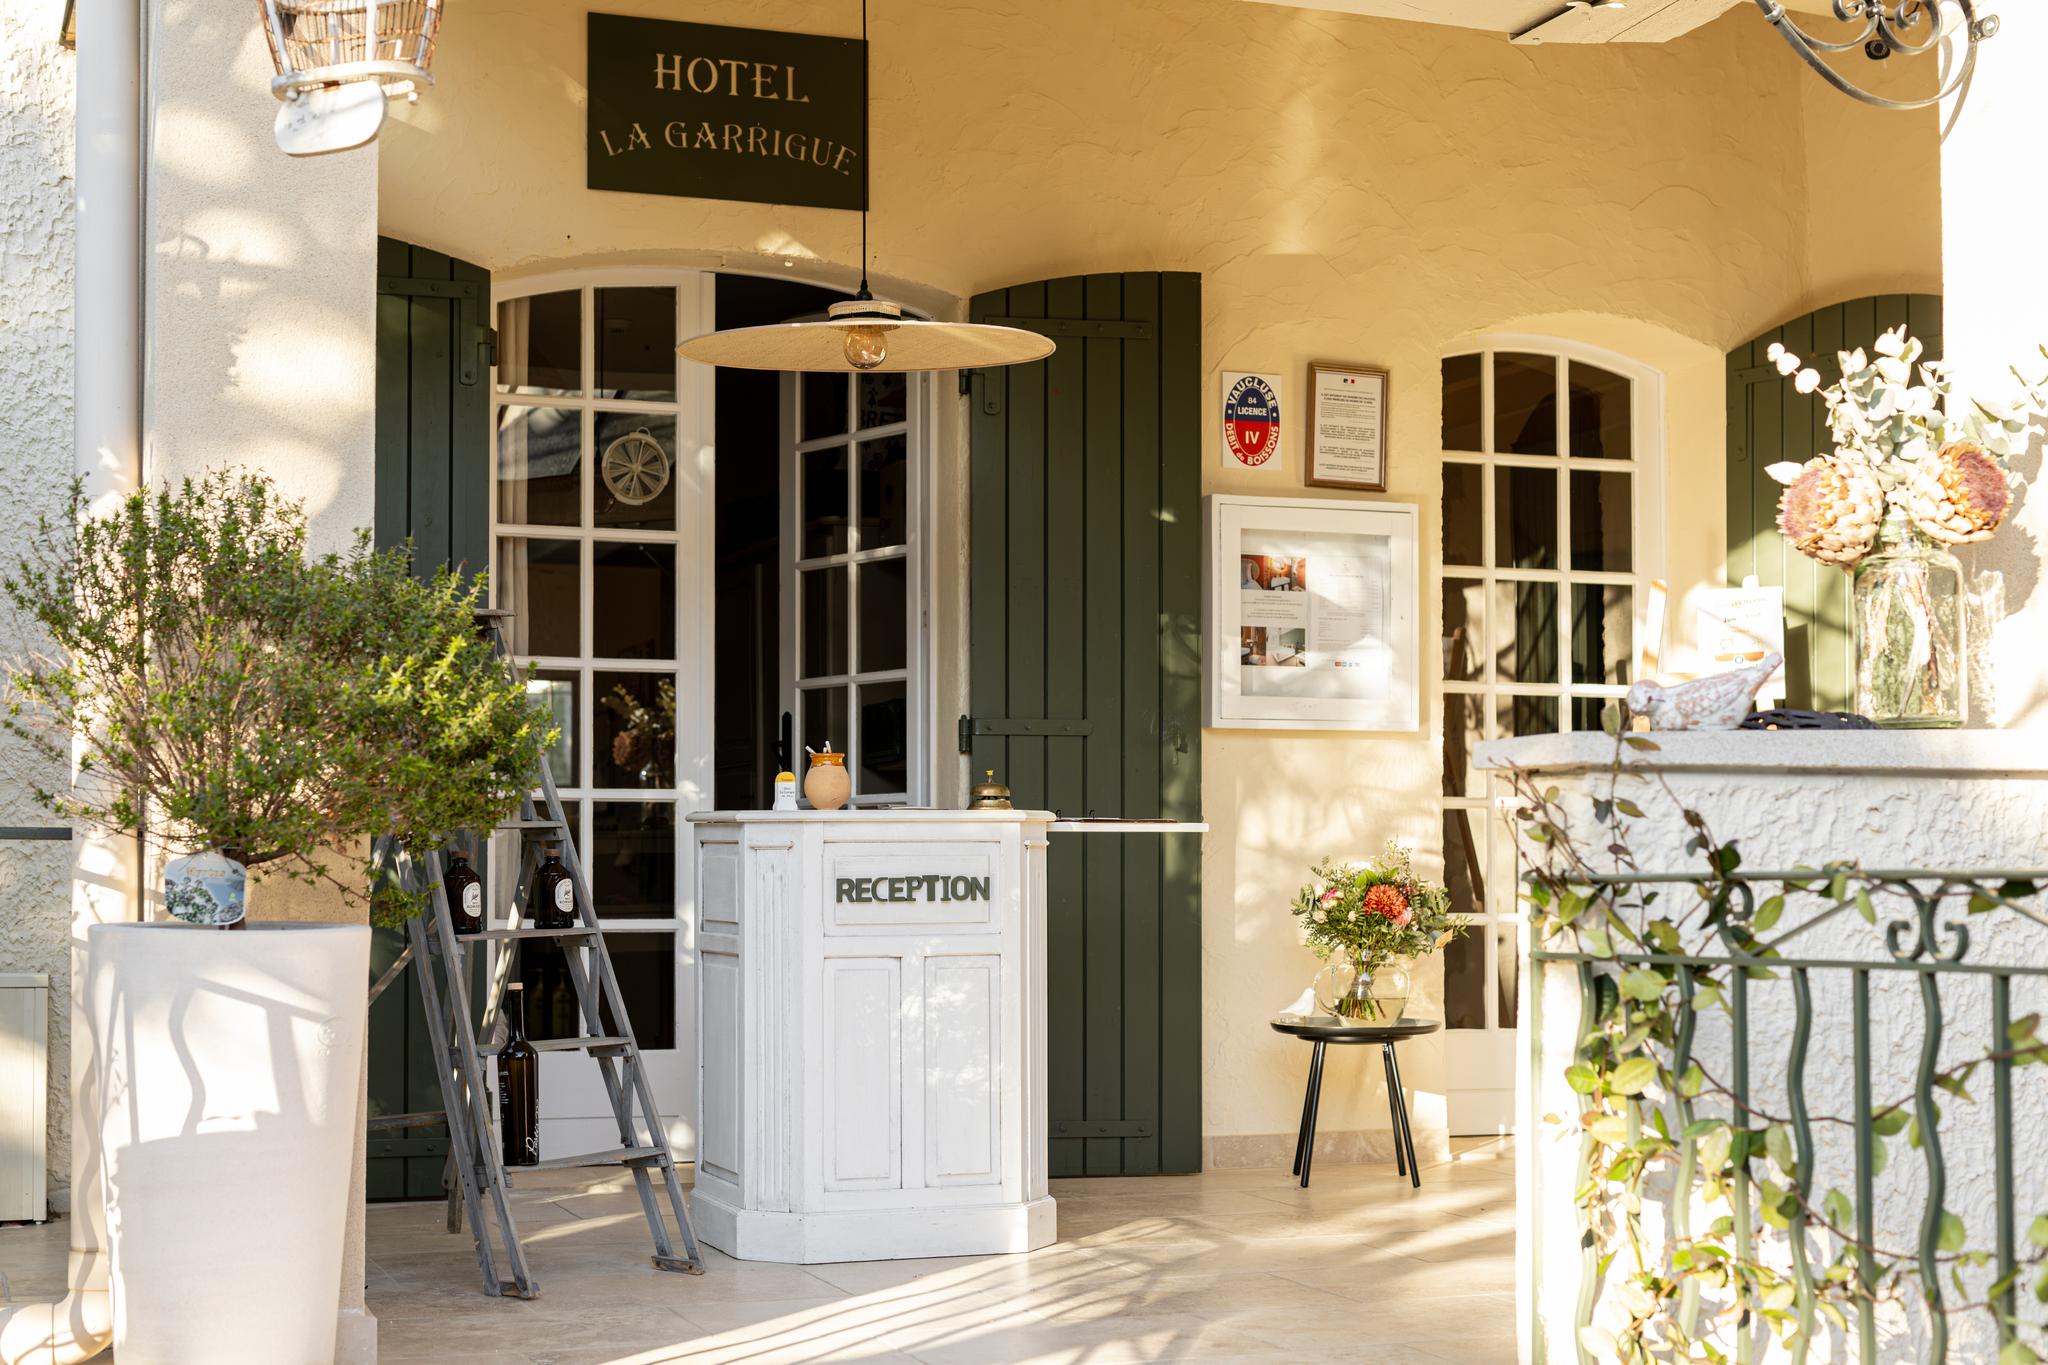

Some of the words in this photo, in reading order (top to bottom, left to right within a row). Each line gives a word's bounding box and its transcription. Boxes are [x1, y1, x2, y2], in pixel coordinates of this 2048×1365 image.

[654, 53, 810, 103] HOTEL
[600, 123, 651, 156] LA
[665, 121, 857, 175] GARRIGUE
[1228, 377, 1277, 409] VAUCLUSE
[1237, 407, 1267, 416] LICENCE
[1226, 423, 1240, 450] DEBIT
[1236, 452, 1245, 461] de
[1247, 426, 1279, 465] BOISSONS
[1245, 430, 1259, 444] IV
[836, 875, 990, 903] RECEPTION
